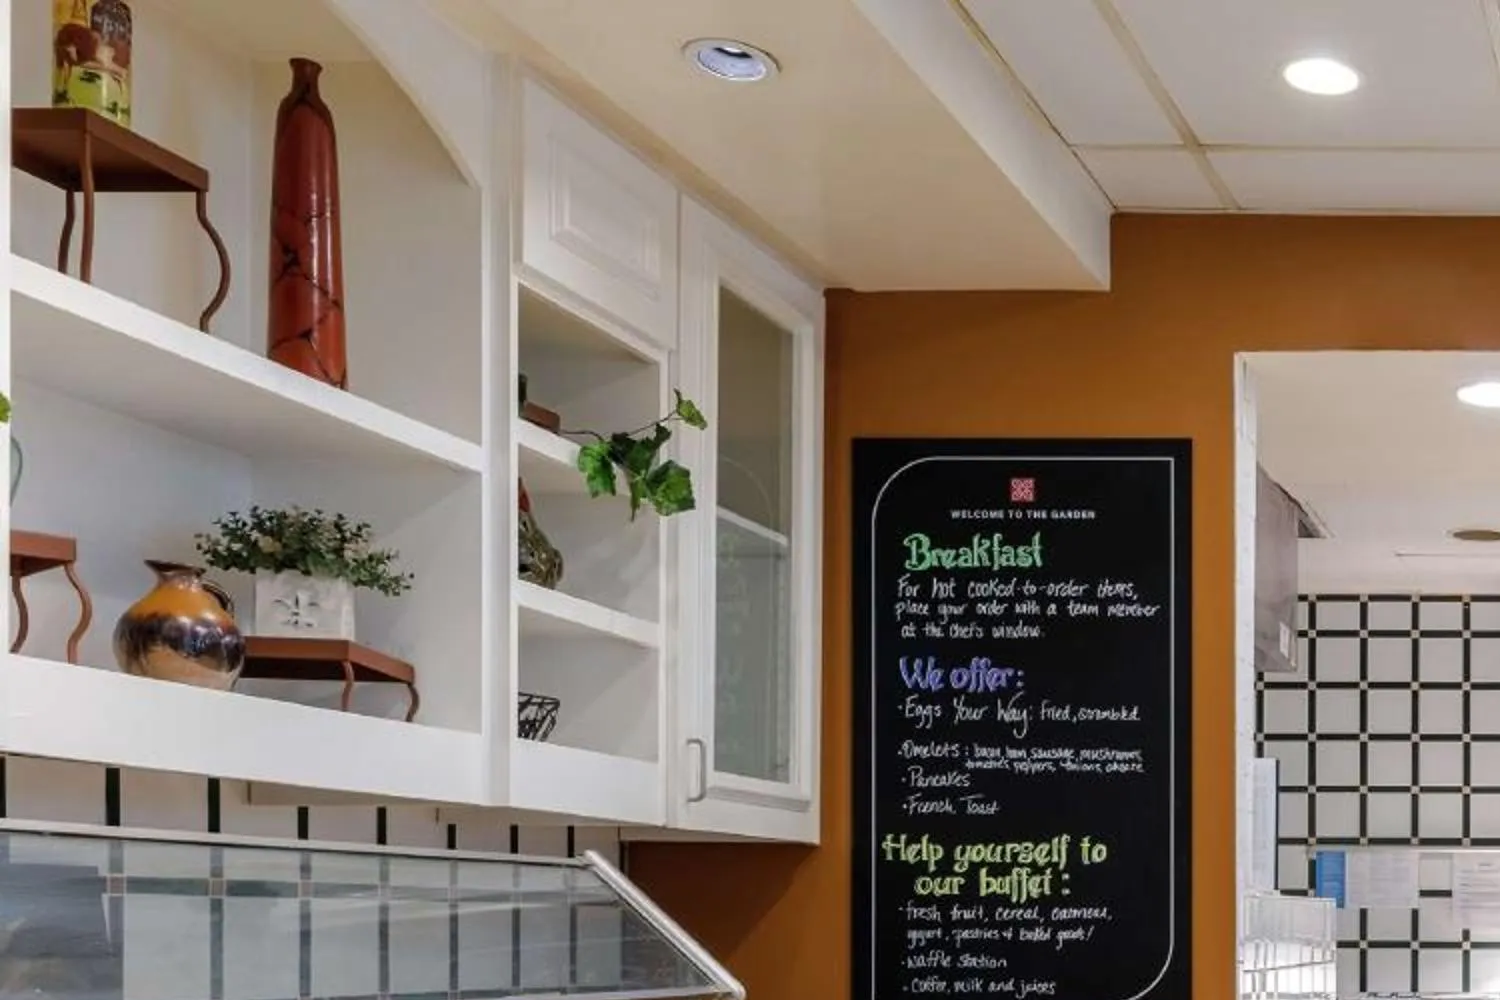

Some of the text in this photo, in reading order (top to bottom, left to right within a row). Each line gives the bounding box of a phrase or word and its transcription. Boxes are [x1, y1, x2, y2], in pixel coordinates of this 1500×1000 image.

[951, 509, 1096, 519] WELCOME TO THE GARDEN
[903, 531, 1044, 571] Breakfast
[898, 573, 920, 598] For
[931, 577, 956, 598] hot
[895, 599, 929, 621] place
[937, 602, 968, 624] your
[975, 599, 1008, 615] order
[1014, 599, 1040, 615] with
[1046, 603, 1057, 615] a
[1067, 600, 1099, 616] team
[901, 621, 916, 638] at
[922, 620, 944, 637] the
[899, 655, 1025, 692] We offer:
[905, 693, 942, 728] Eggs
[953, 694, 988, 725] Your
[907, 765, 970, 787] Pancakes
[907, 792, 1000, 815] French Toast
[882, 833, 1108, 873] Help yourself to
[914, 874, 965, 896] our
[987, 977, 1015, 993] and
[1015, 979, 1056, 1000] juices
